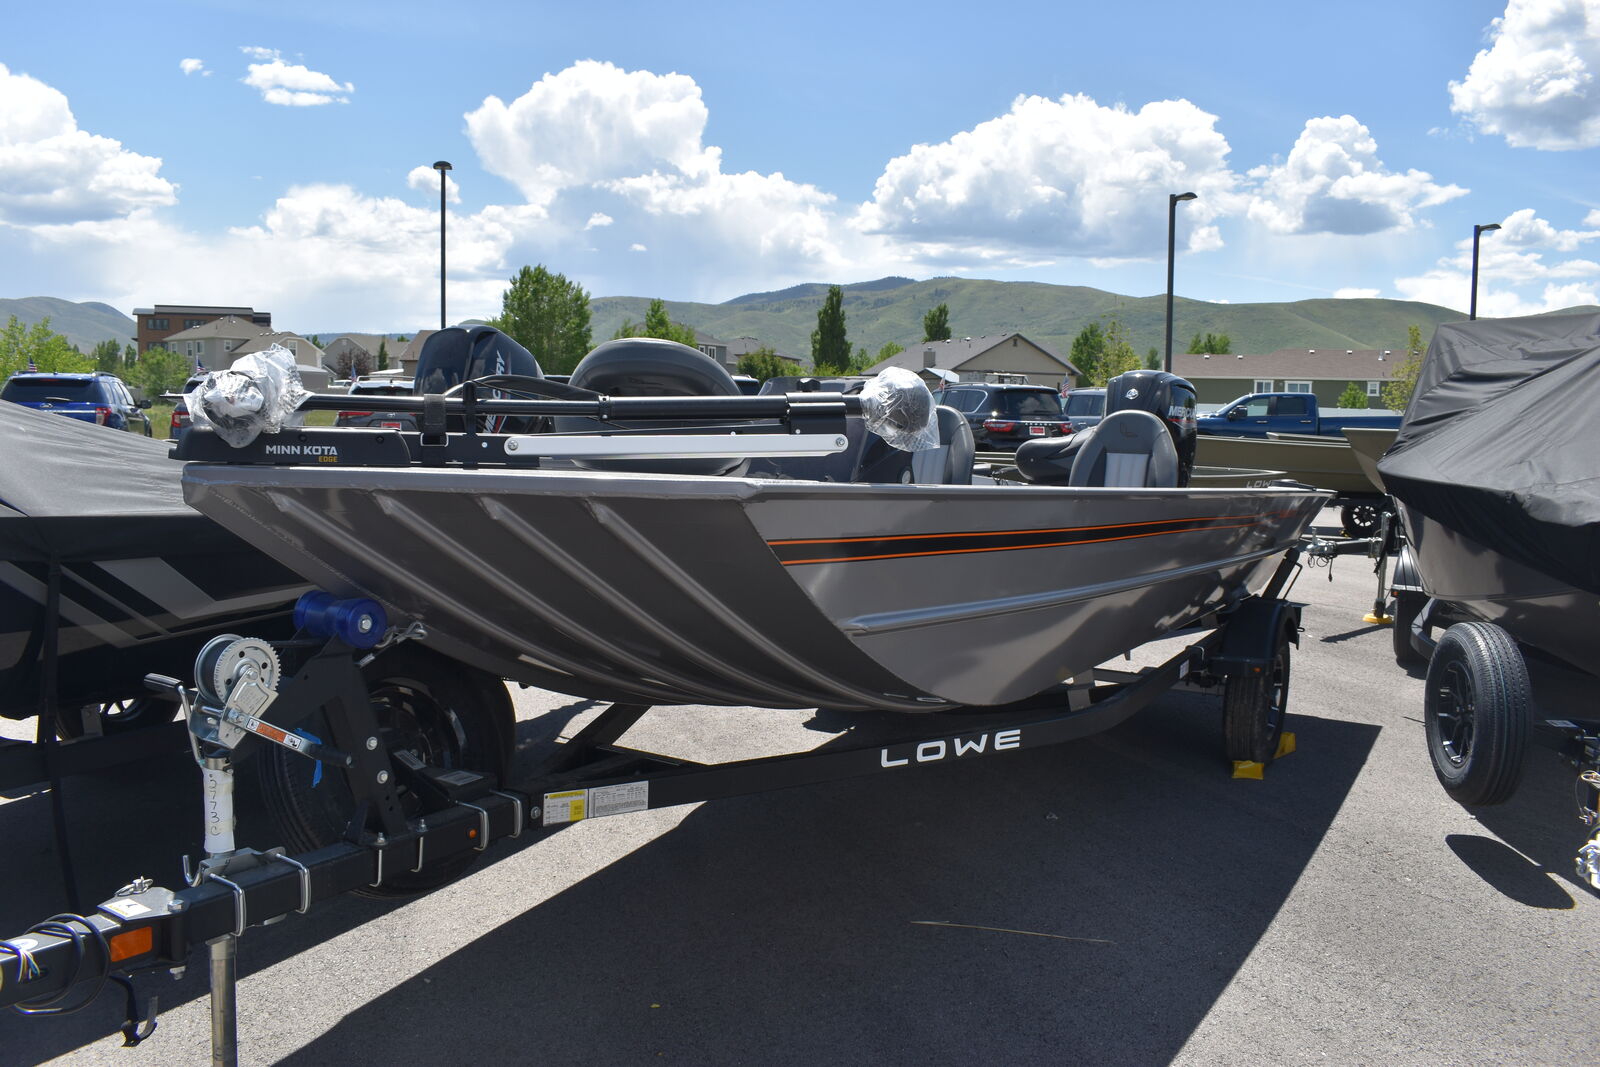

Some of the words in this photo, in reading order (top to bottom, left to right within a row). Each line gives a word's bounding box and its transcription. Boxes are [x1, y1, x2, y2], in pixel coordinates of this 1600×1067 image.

[482, 350, 505, 433] MECRY
[1168, 406, 1196, 418] MERCU
[265, 445, 300, 454] MINN
[303, 446, 338, 455] KOTA
[1246, 480, 1273, 488] LOW
[881, 729, 1021, 768] LOWE
